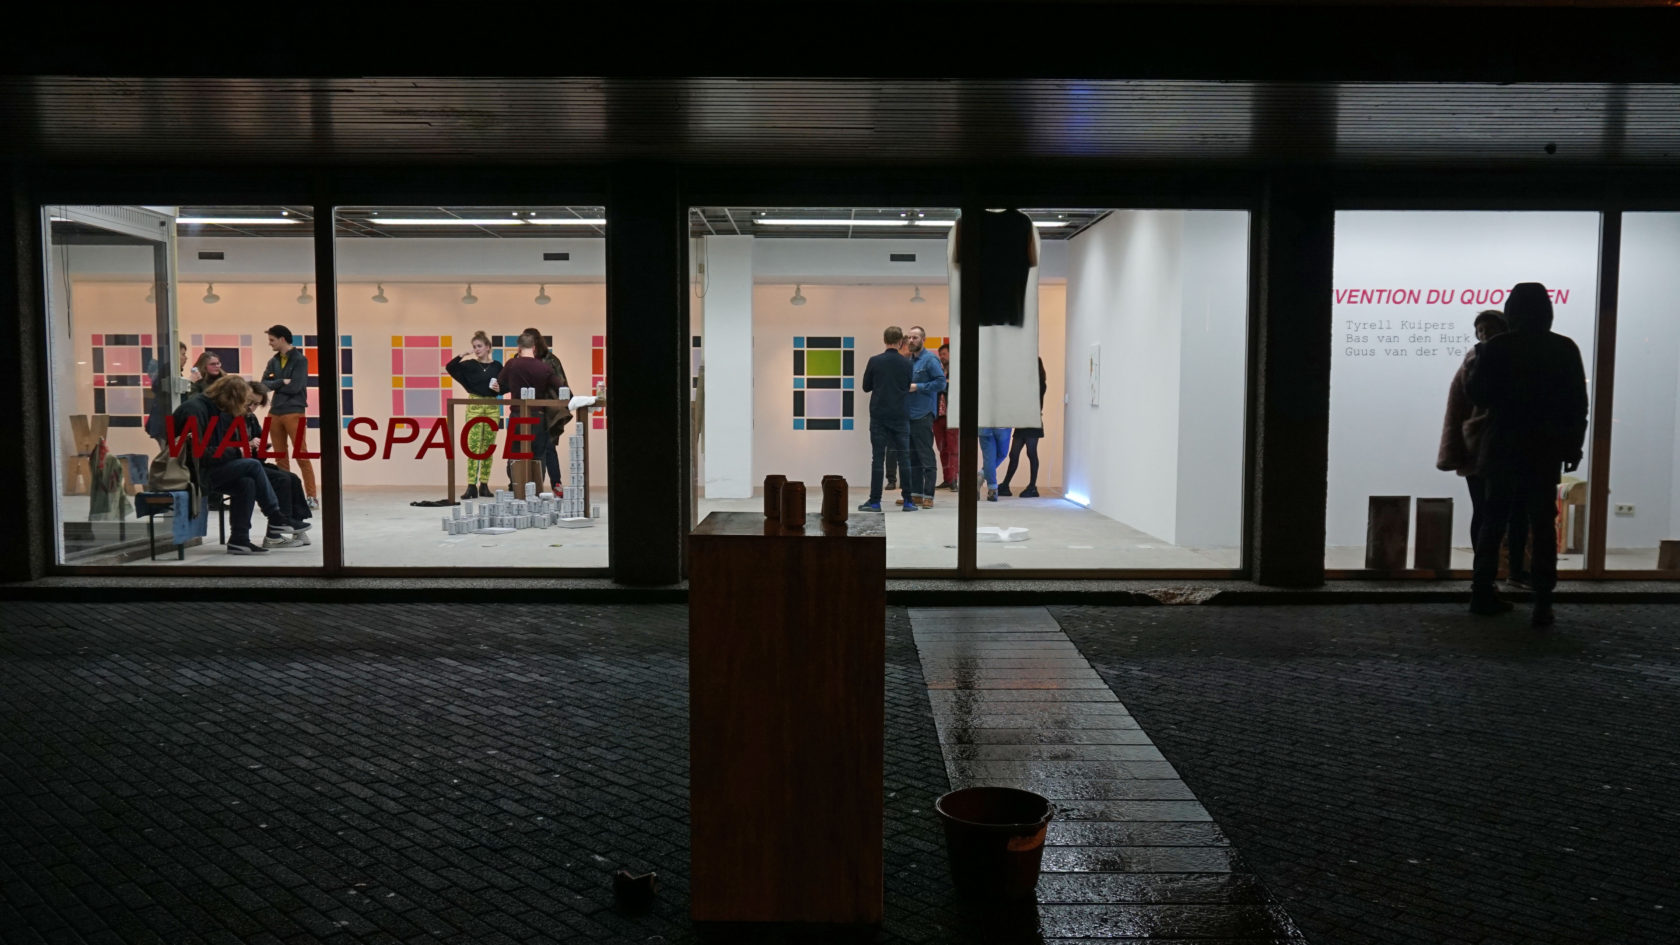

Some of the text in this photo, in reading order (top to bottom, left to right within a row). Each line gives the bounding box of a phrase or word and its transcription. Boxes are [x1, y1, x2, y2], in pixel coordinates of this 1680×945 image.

[1333, 288, 1421, 304] VENTION
[1426, 289, 1455, 305] DU
[1345, 320, 1455, 332] Tyrell Kuipers
[1346, 333, 1470, 343] Bas van den Hurk
[1345, 346, 1376, 357] Guus
[1384, 348, 1407, 356] van
[1415, 346, 1438, 356] der
[165, 415, 541, 460] WALL SPACE
